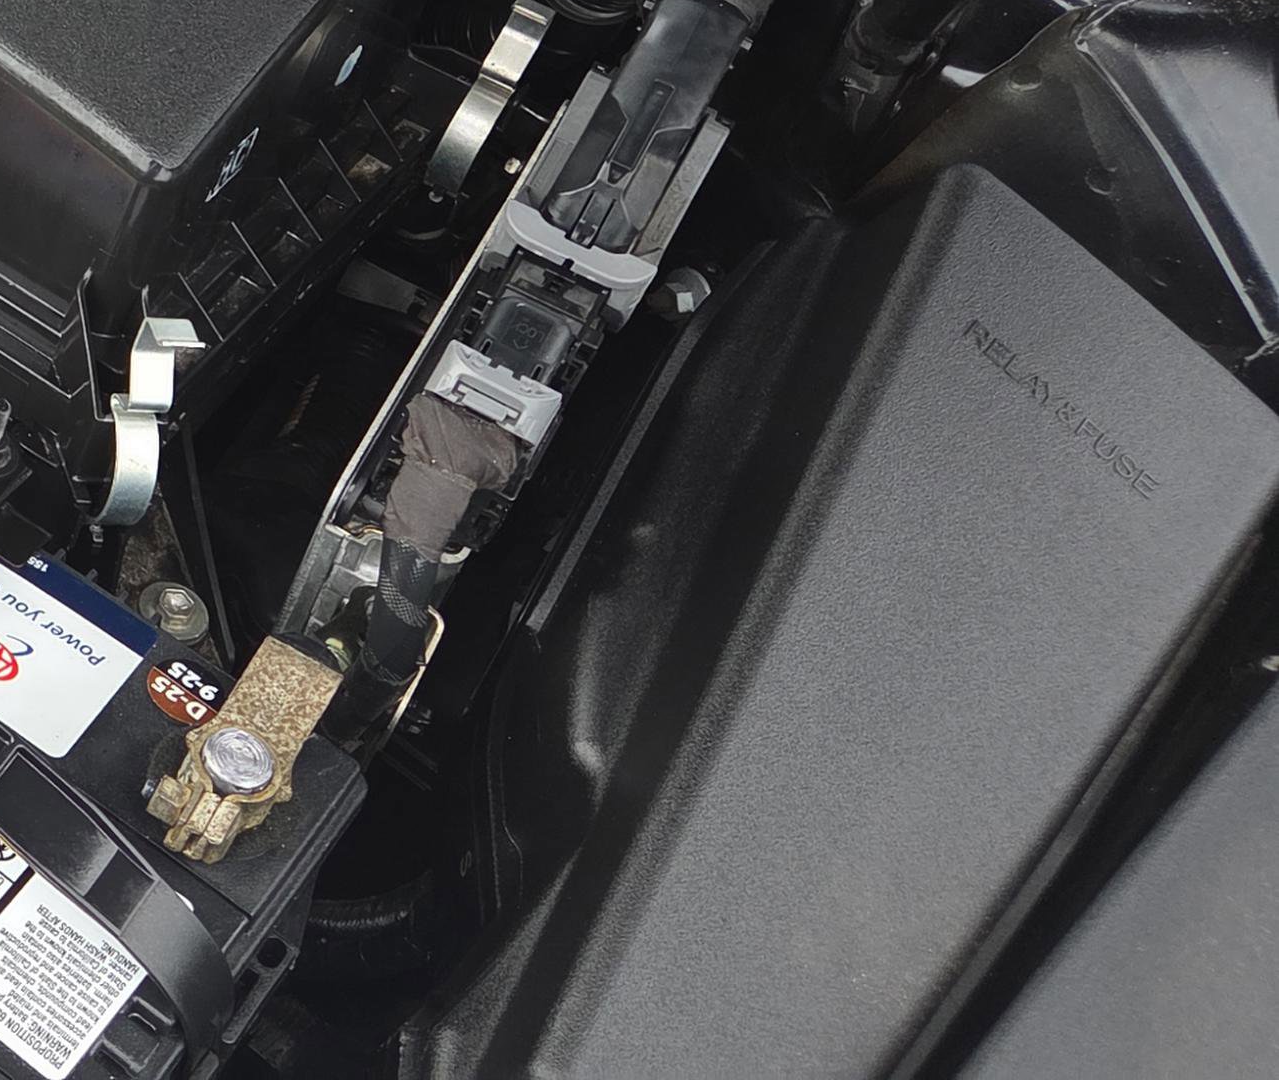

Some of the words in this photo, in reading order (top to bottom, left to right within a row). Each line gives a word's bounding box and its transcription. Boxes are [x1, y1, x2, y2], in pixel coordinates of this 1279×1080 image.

[26, 553, 50, 573] 155
[1, 590, 41, 622] you
[40, 618, 106, 667] Power
[166, 658, 219, 702] 9-25
[149, 673, 208, 721] D-25
[35, 903, 61, 926] AFTER
[22, 919, 38, 934] the
[34, 928, 45, 939] to
[37, 917, 60, 937] cause
[57, 920, 86, 946] HANDS
[19, 929, 48, 955] contain
[40, 934, 67, 957] known
[56, 933, 68, 944] to
[45, 950, 63, 967] also
[64, 939, 101, 970] California
[83, 940, 108, 963] WASH
[97, 938, 140, 975] HANDLING.
[0, 954, 37, 986] chemicals
[28, 963, 41, 976] of
[38, 958, 56, 974] and
[64, 951, 101, 983] chemicals
[96, 964, 108, 976] of
[3, 972, 21, 989] lead
[36, 970, 58, 990] State
[53, 968, 78, 990] cancer
[97, 978, 121, 999] other
[105, 971, 127, 991] State
[6, 988, 34, 1012] related
[18, 983, 47, 1009] contain
[54, 985, 70, 1000] the
[67, 994, 78, 1006] to
[76, 987, 99, 1008] cause
[1, 996, 30, 1023] Battery
[31, 1007, 48, 1023] and
[74, 1000, 101, 1024] known
[96, 1004, 108, 1015] to
[45, 1004, 87, 1040] accessories
[45, 1018, 80, 1049] terminals
[75, 1015, 94, 1032] lead
[2, 1015, 66, 1069] PROPOSITION
[24, 1017, 73, 1059] WARNING:
